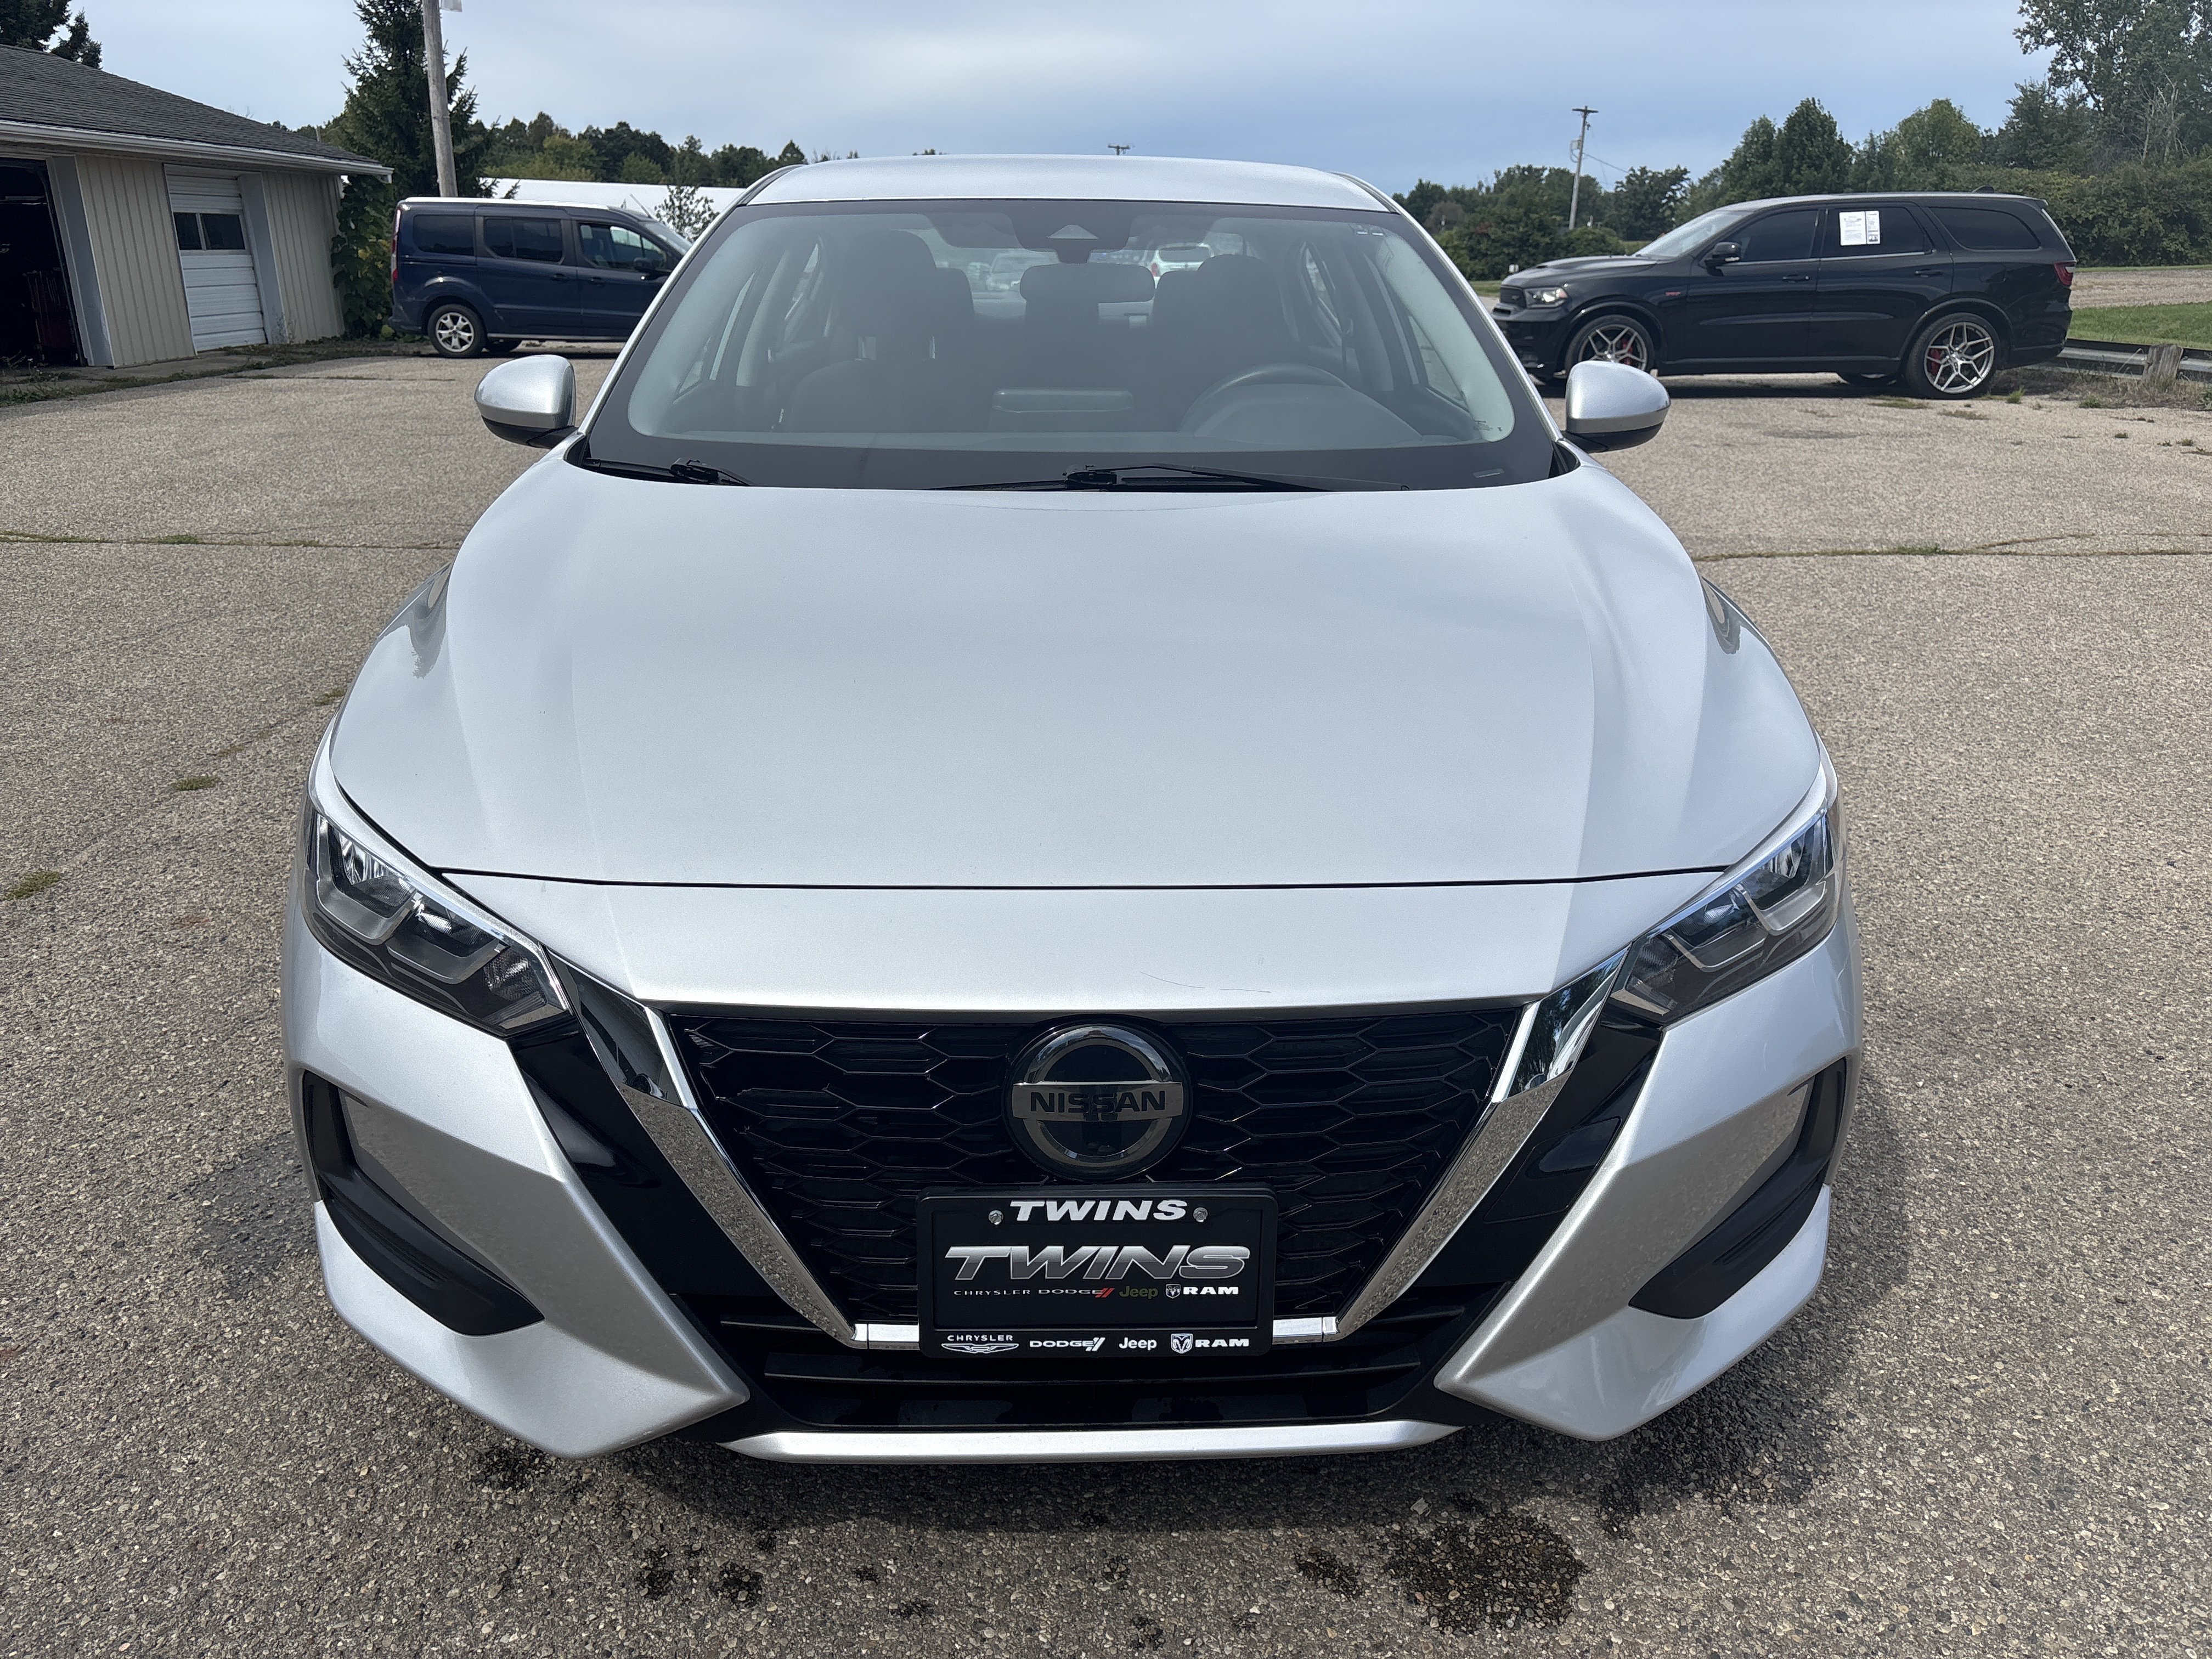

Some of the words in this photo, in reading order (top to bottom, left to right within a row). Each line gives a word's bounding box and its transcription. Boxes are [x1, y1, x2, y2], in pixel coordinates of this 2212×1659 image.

[1030, 1091, 1165, 1113] NISSAN
[1010, 1200, 1188, 1221] TWINS
[945, 1245, 1251, 1280] TWINS
[1119, 1285, 1158, 1299] Jeep
[1183, 1286, 1239, 1295] RAM
[1119, 1337, 1157, 1350] Jeep
[1195, 1339, 1249, 1347] RAM
